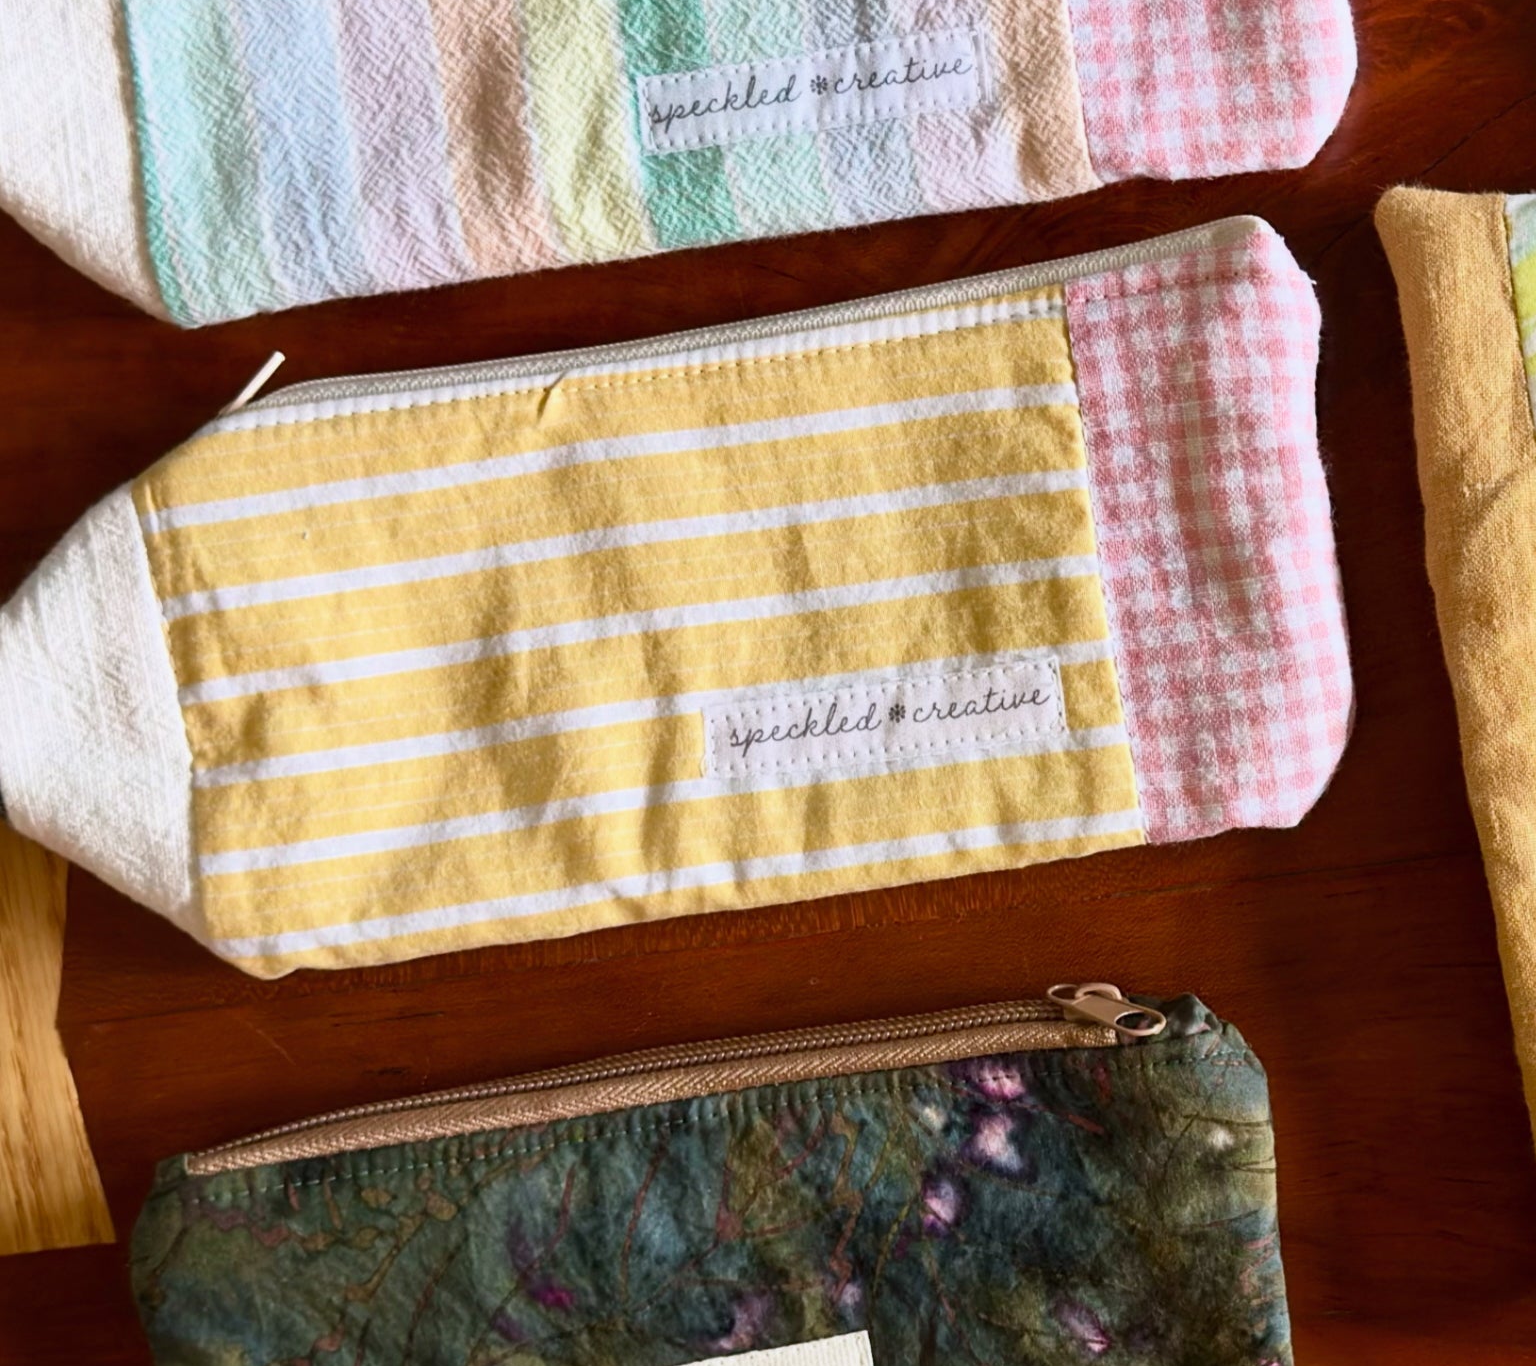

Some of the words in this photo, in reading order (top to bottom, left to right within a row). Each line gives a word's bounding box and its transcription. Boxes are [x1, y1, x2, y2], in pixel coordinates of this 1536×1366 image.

[649, 75, 801, 133] speckled
[834, 57, 973, 95] creative
[730, 703, 882, 757] speckled
[913, 687, 1050, 723] creative
